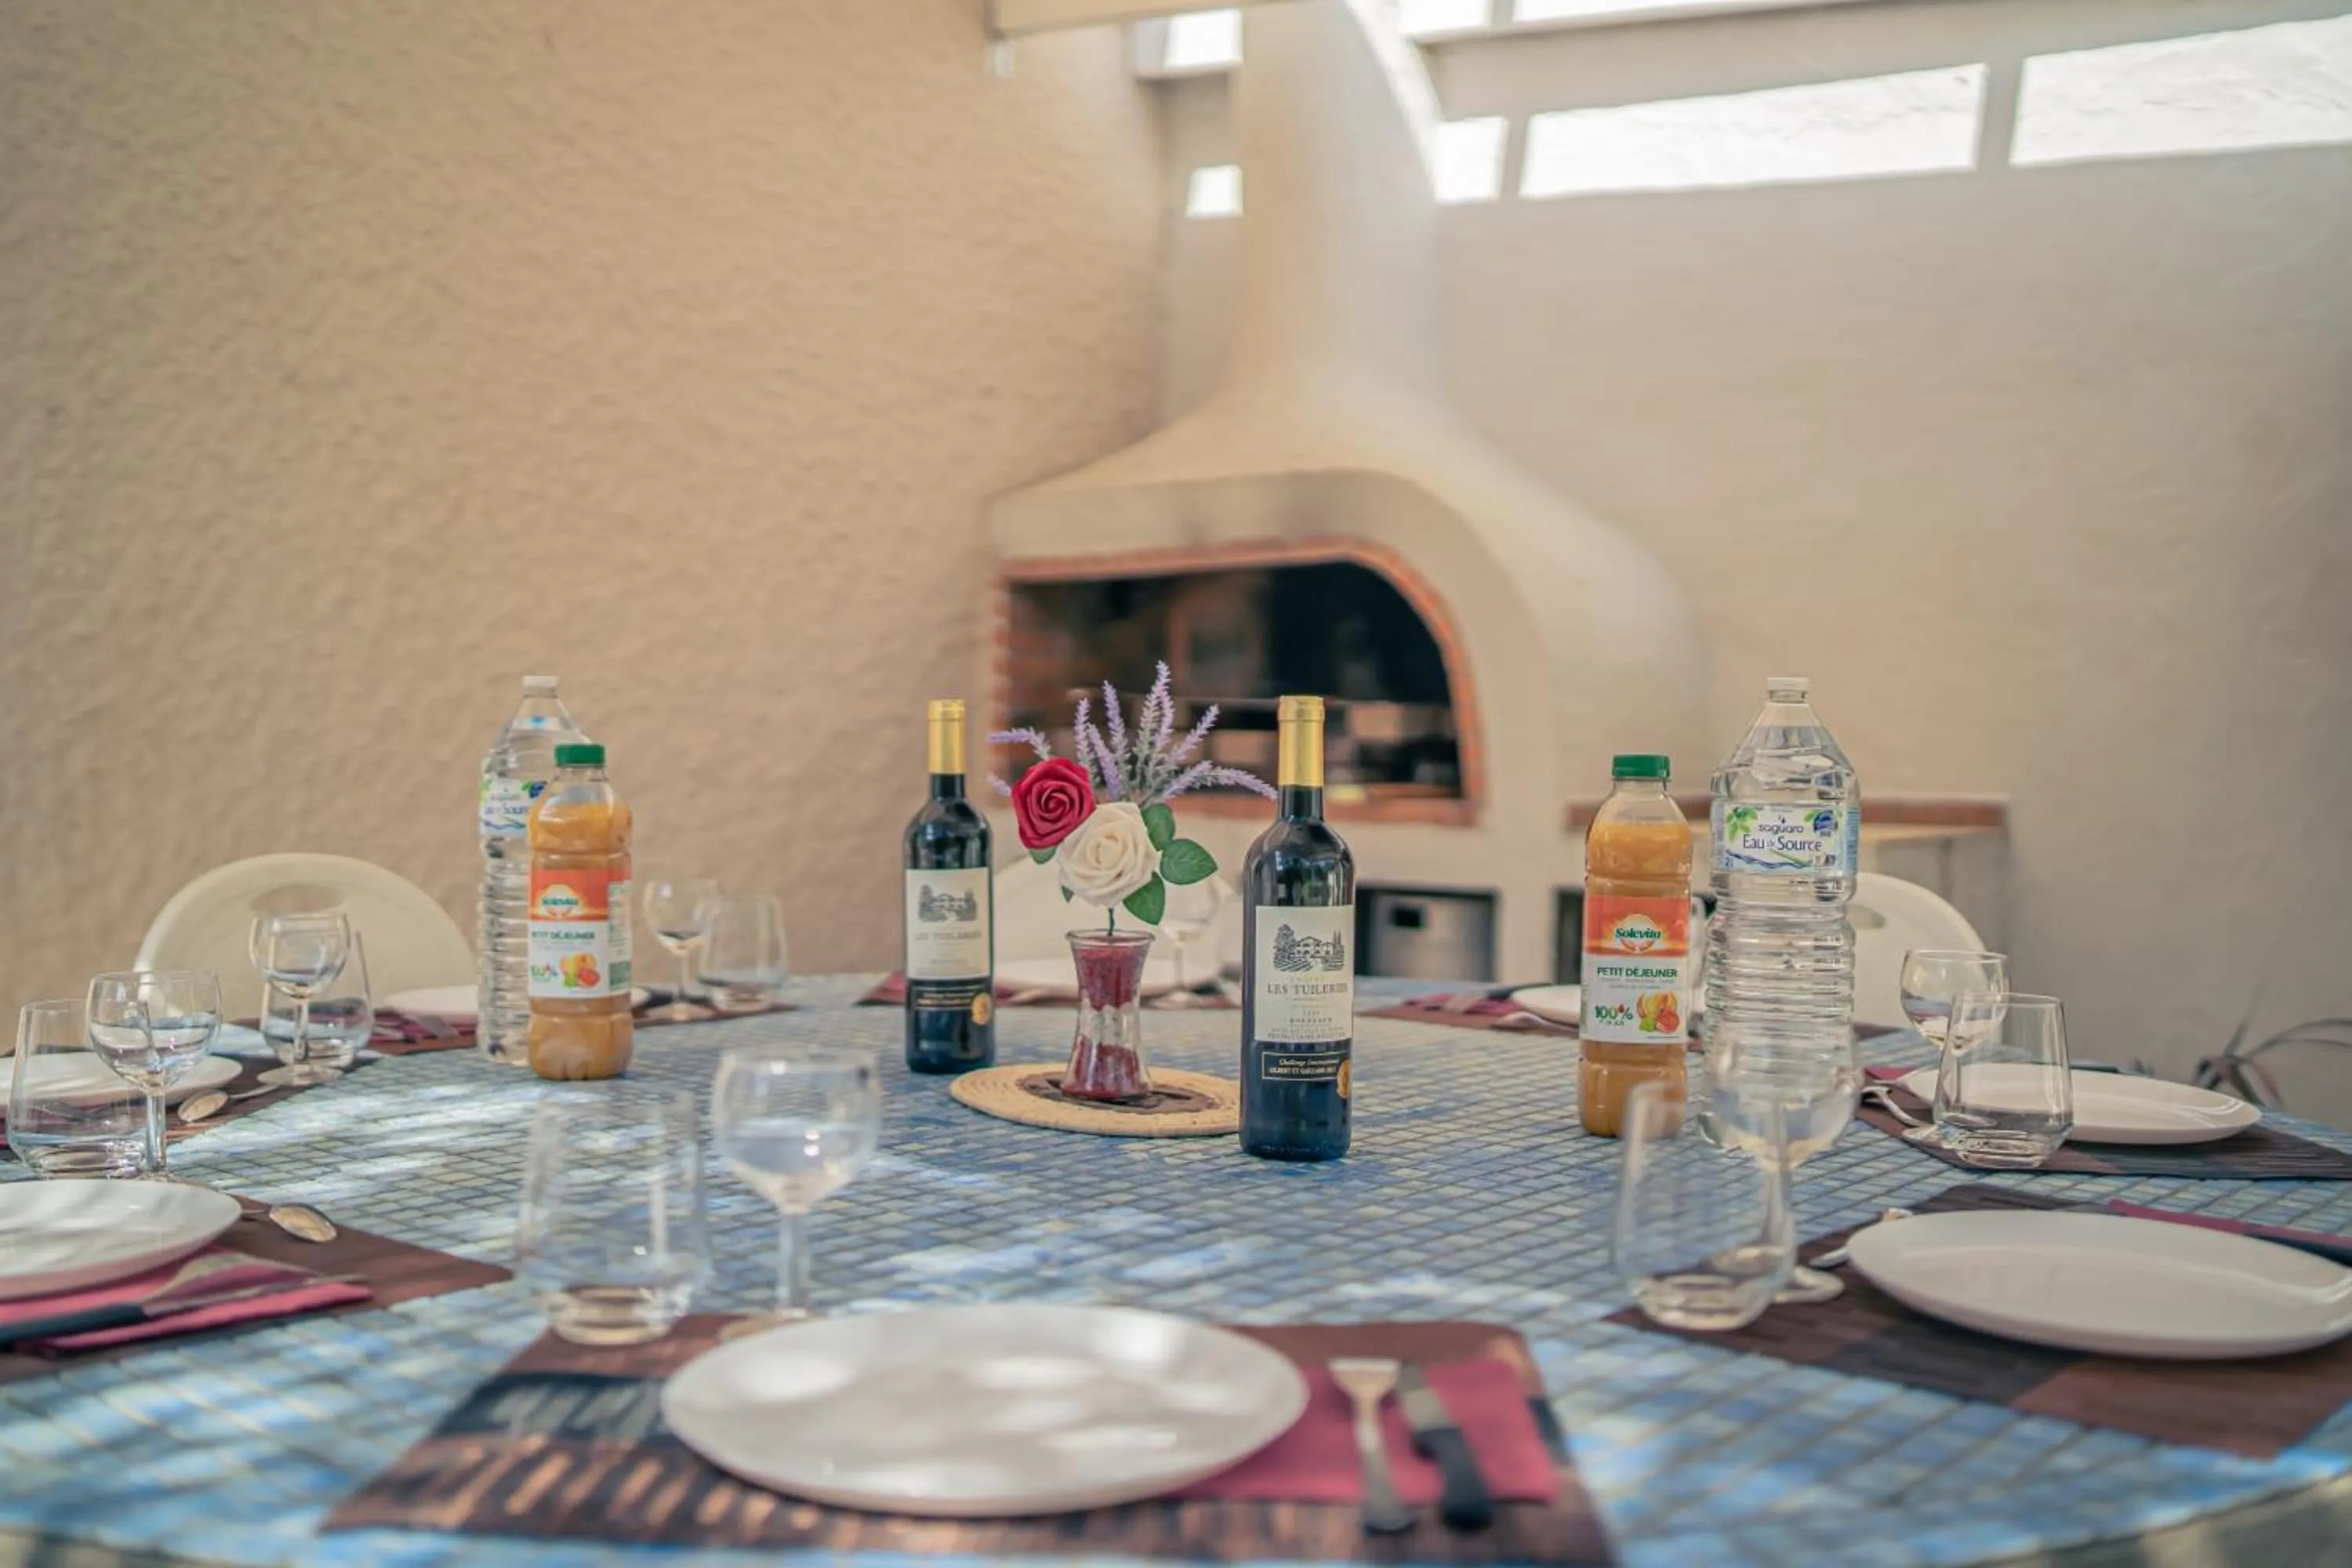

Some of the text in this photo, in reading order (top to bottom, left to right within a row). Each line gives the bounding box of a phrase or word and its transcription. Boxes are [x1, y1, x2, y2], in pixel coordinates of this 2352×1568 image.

[1759, 824, 1804, 835] saguaro
[1743, 834, 1764, 849] Eau
[1777, 836, 1822, 851] Source
[1616, 927, 1661, 938] Solevita
[1597, 966, 1678, 978] PETIT DÉJEUNER
[1268, 983, 1288, 994] LES
[1595, 1004, 1634, 1019] 100%
